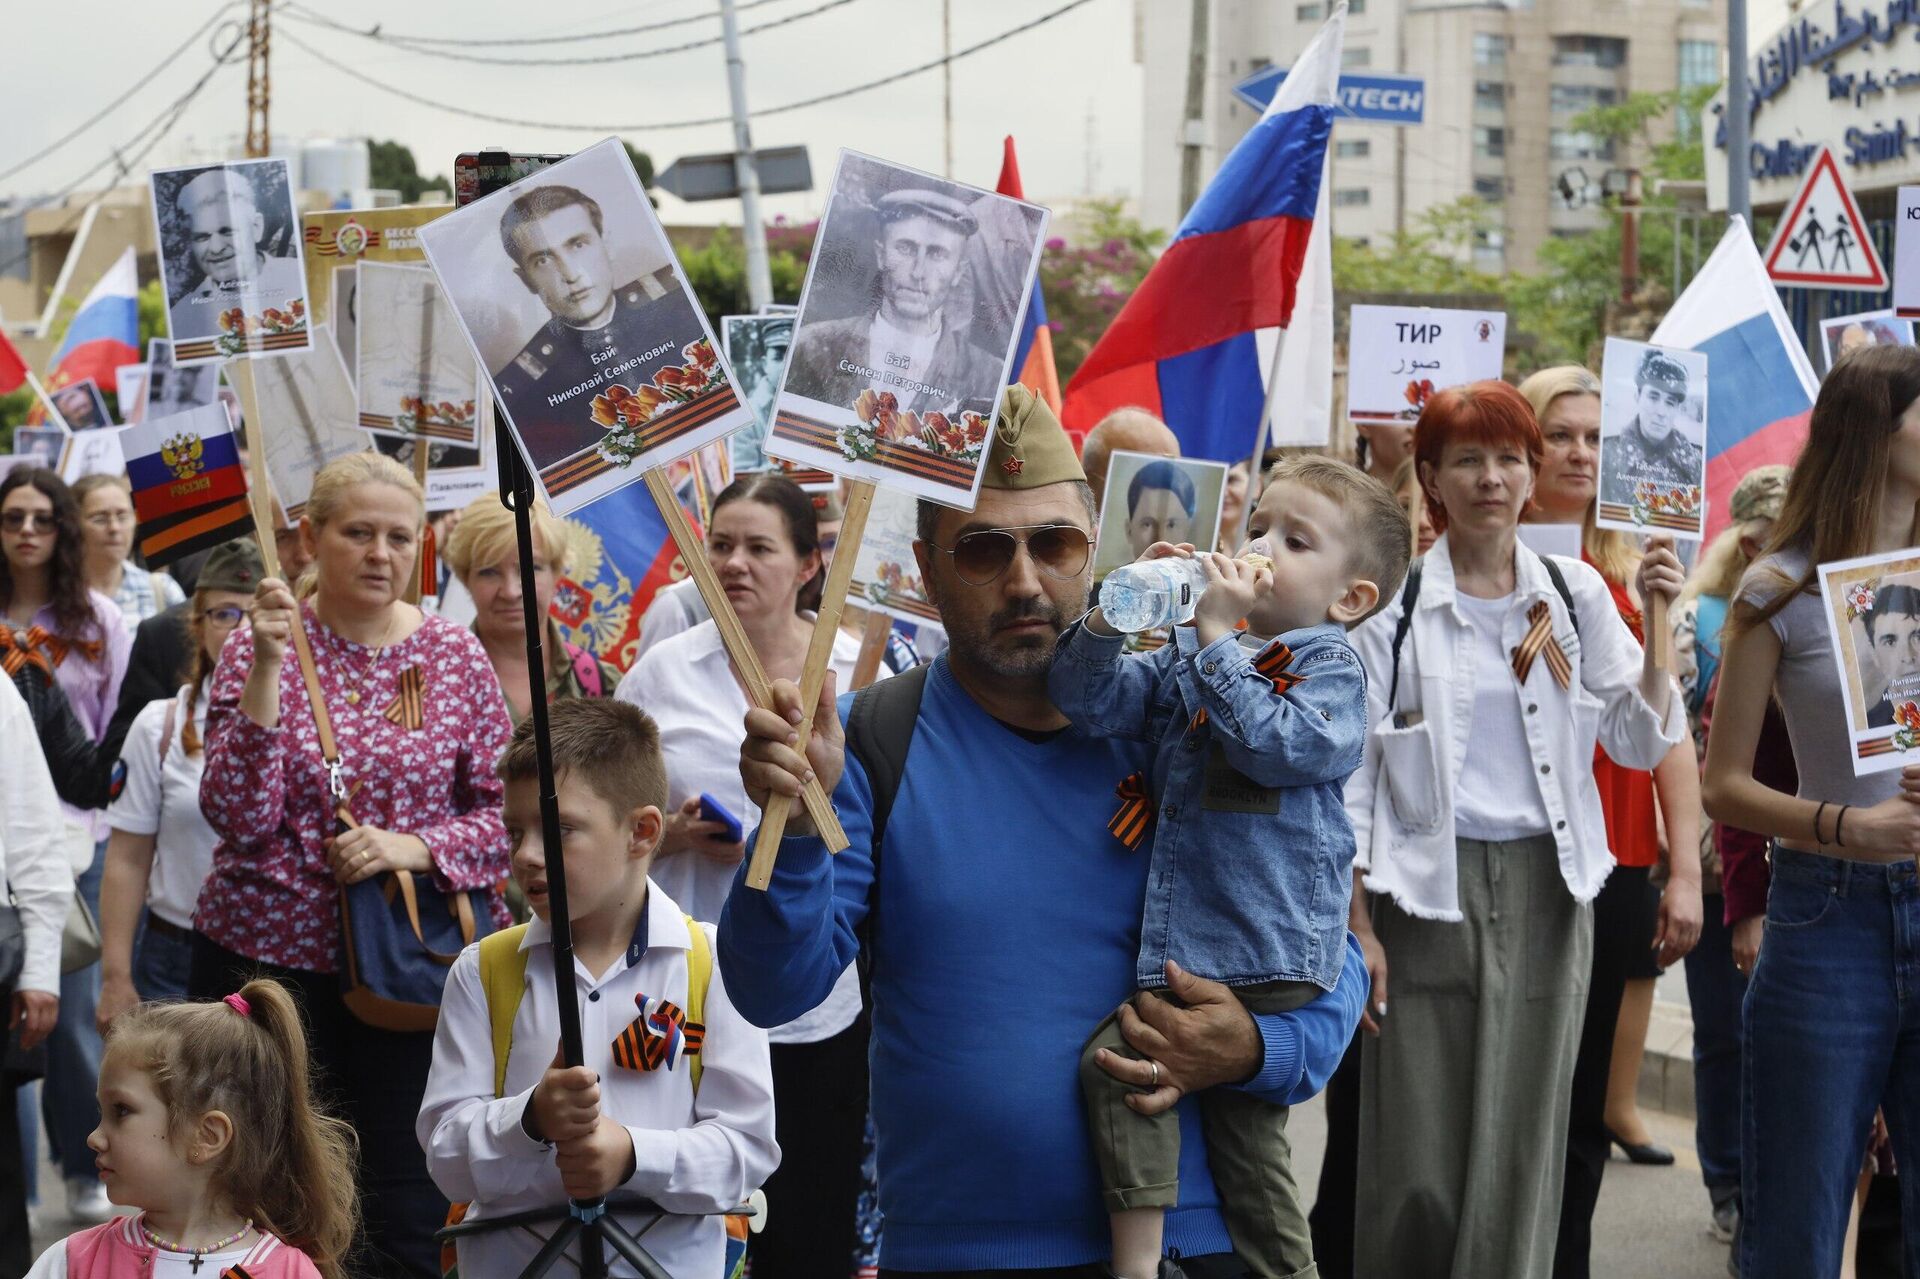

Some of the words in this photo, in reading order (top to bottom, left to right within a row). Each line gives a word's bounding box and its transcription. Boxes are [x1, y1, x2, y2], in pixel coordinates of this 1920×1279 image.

[1395, 323, 1442, 344] ТИР
[590, 345, 616, 365] Бай
[884, 352, 911, 369] Бай
[547, 372, 604, 407] Николай
[604, 340, 676, 379] Семенович
[1391, 358, 1440, 375] صور
[839, 359, 882, 380] Семен
[882, 371, 947, 399] Петрович
